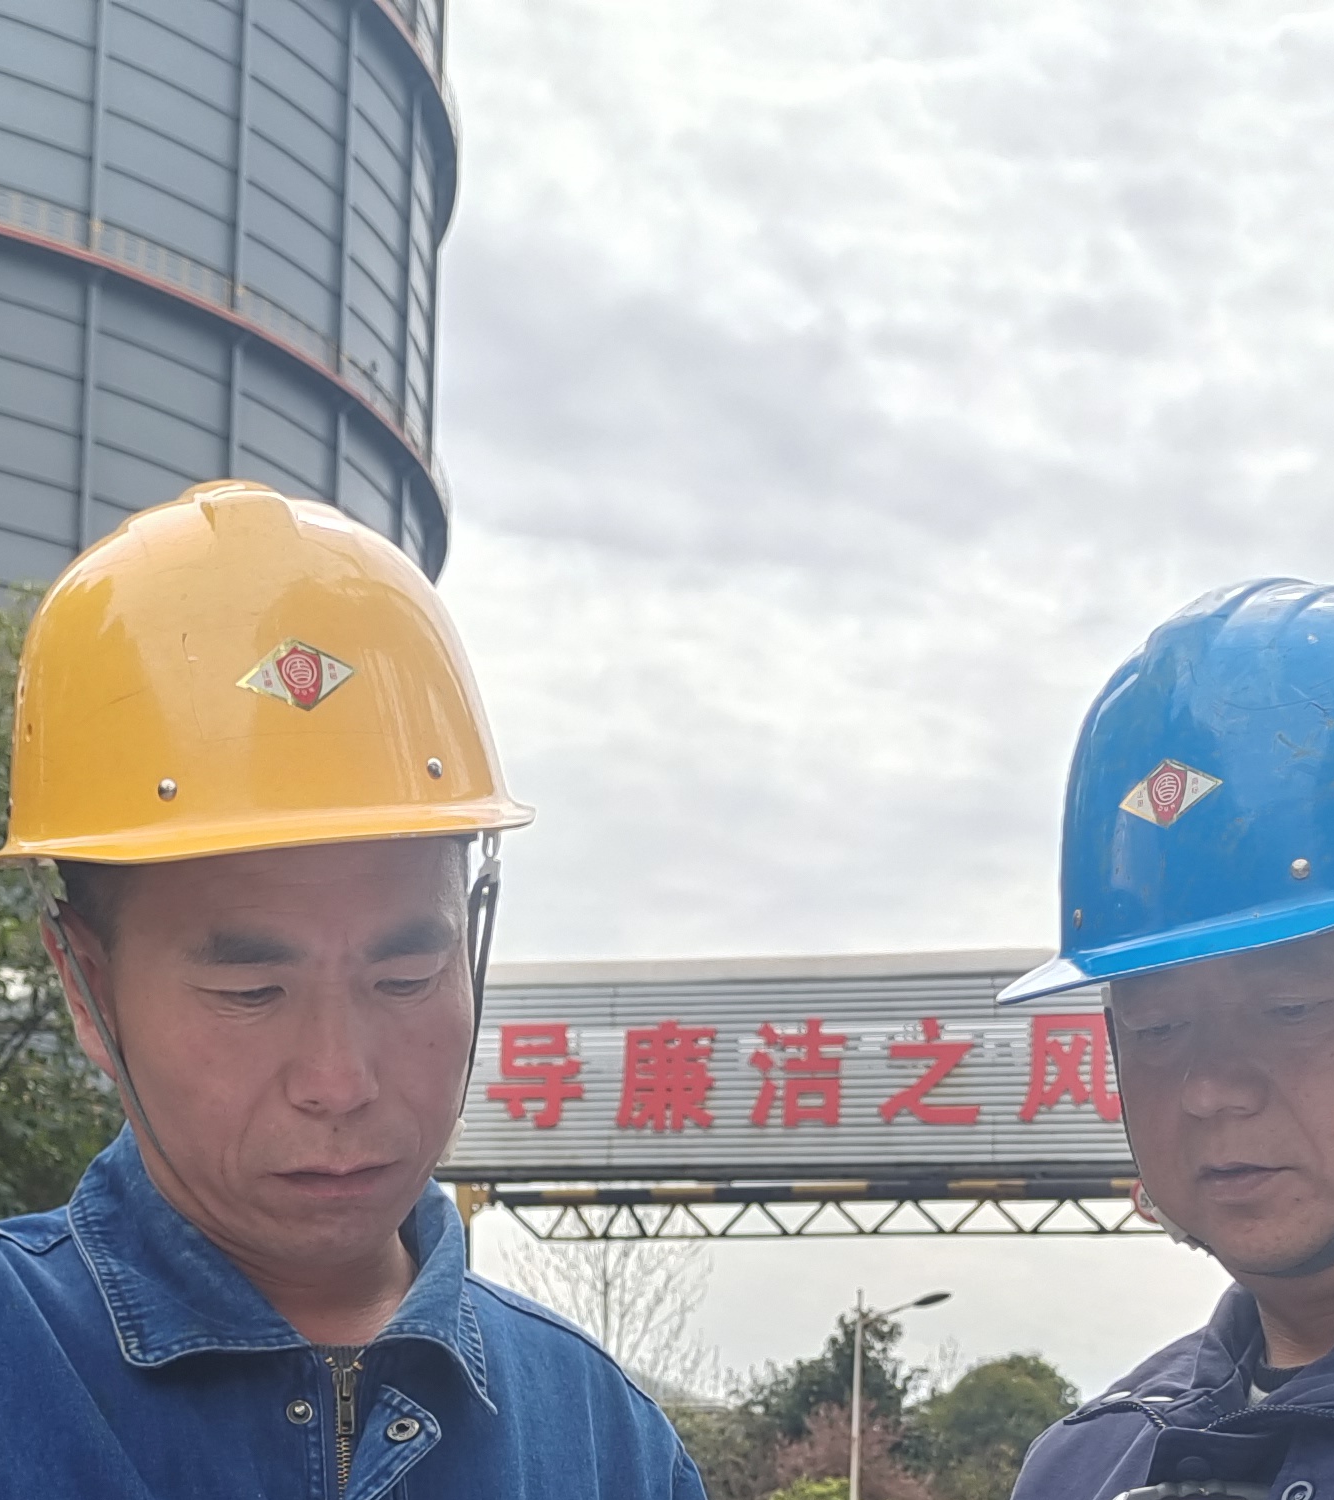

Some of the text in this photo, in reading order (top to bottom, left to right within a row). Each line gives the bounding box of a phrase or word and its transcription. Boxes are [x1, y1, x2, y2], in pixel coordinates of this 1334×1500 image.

[485, 1015, 1122, 1132] 导廉洁之风
